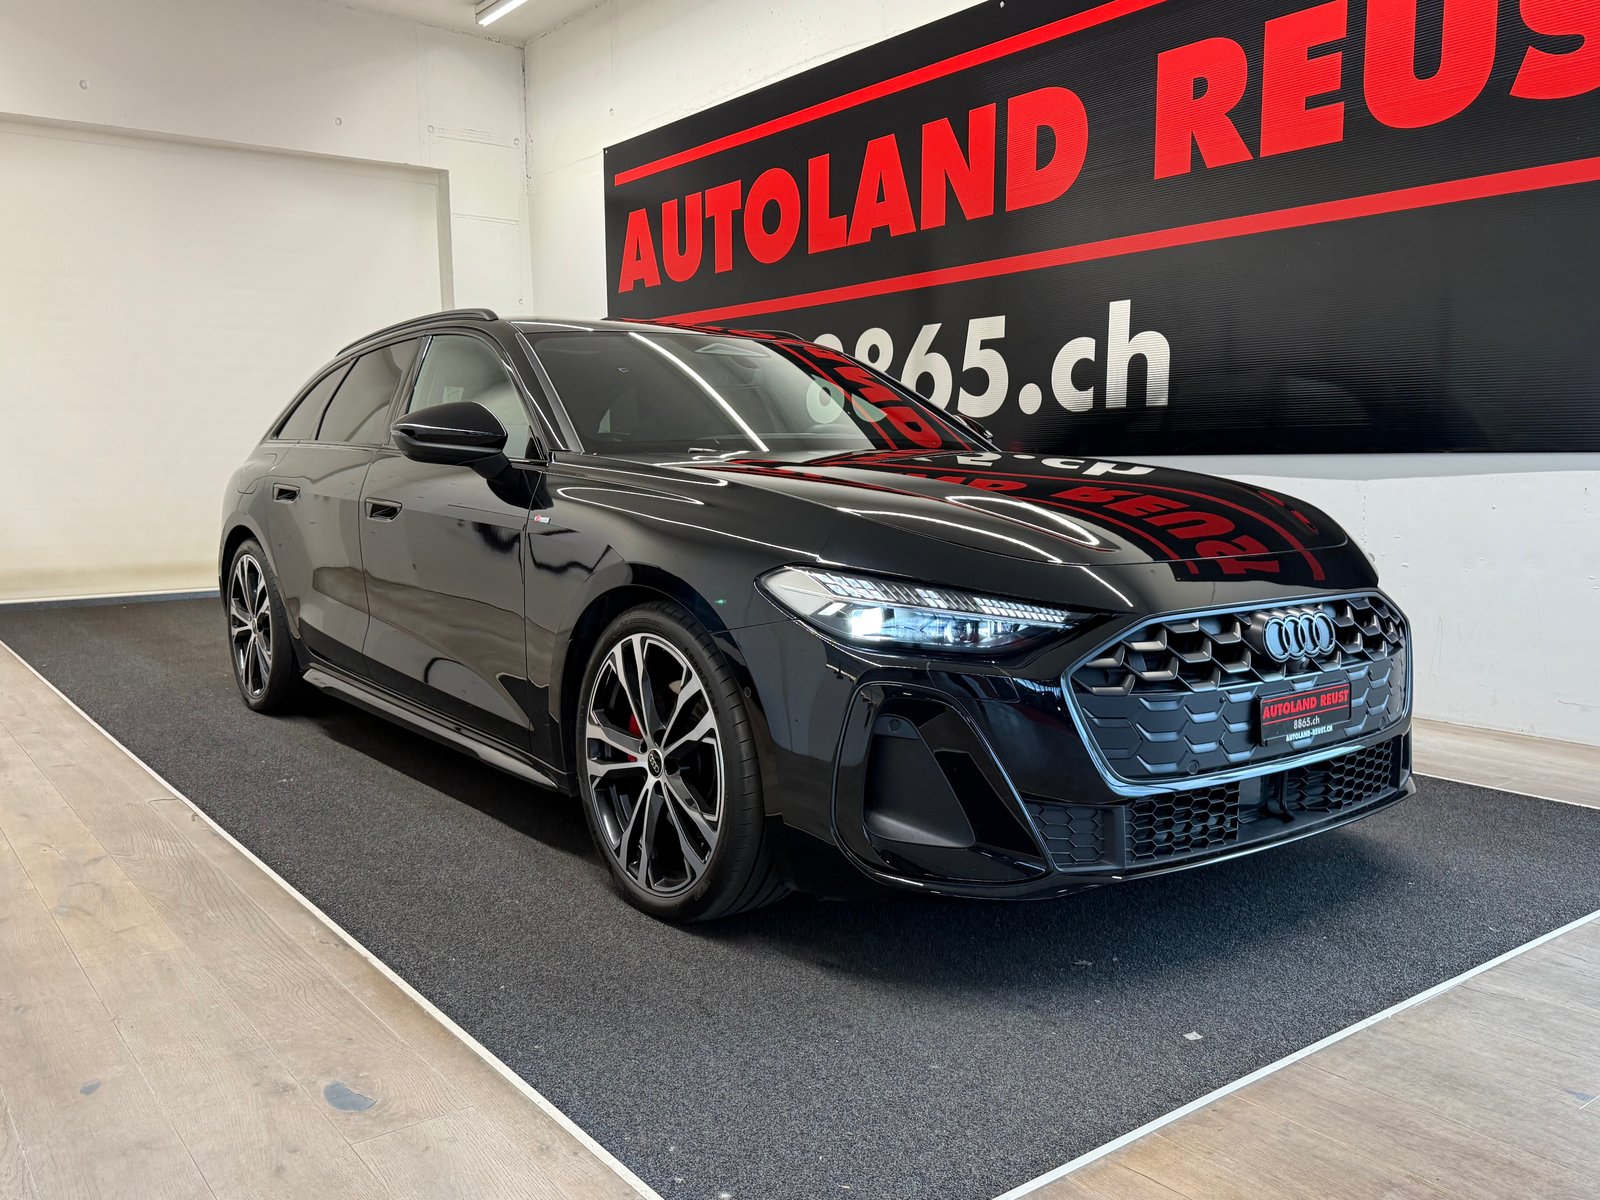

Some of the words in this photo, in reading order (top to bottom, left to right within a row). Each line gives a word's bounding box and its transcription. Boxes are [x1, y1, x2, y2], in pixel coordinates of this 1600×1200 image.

[617, 86, 1089, 294] AUTOLAND
[1263, 696, 1317, 719] AUTOLAND
[1320, 690, 1349, 707] REUST
[1285, 725, 1333, 742] AUTOLAND-REUST.CH
[1293, 715, 1320, 730] 8865.ch
